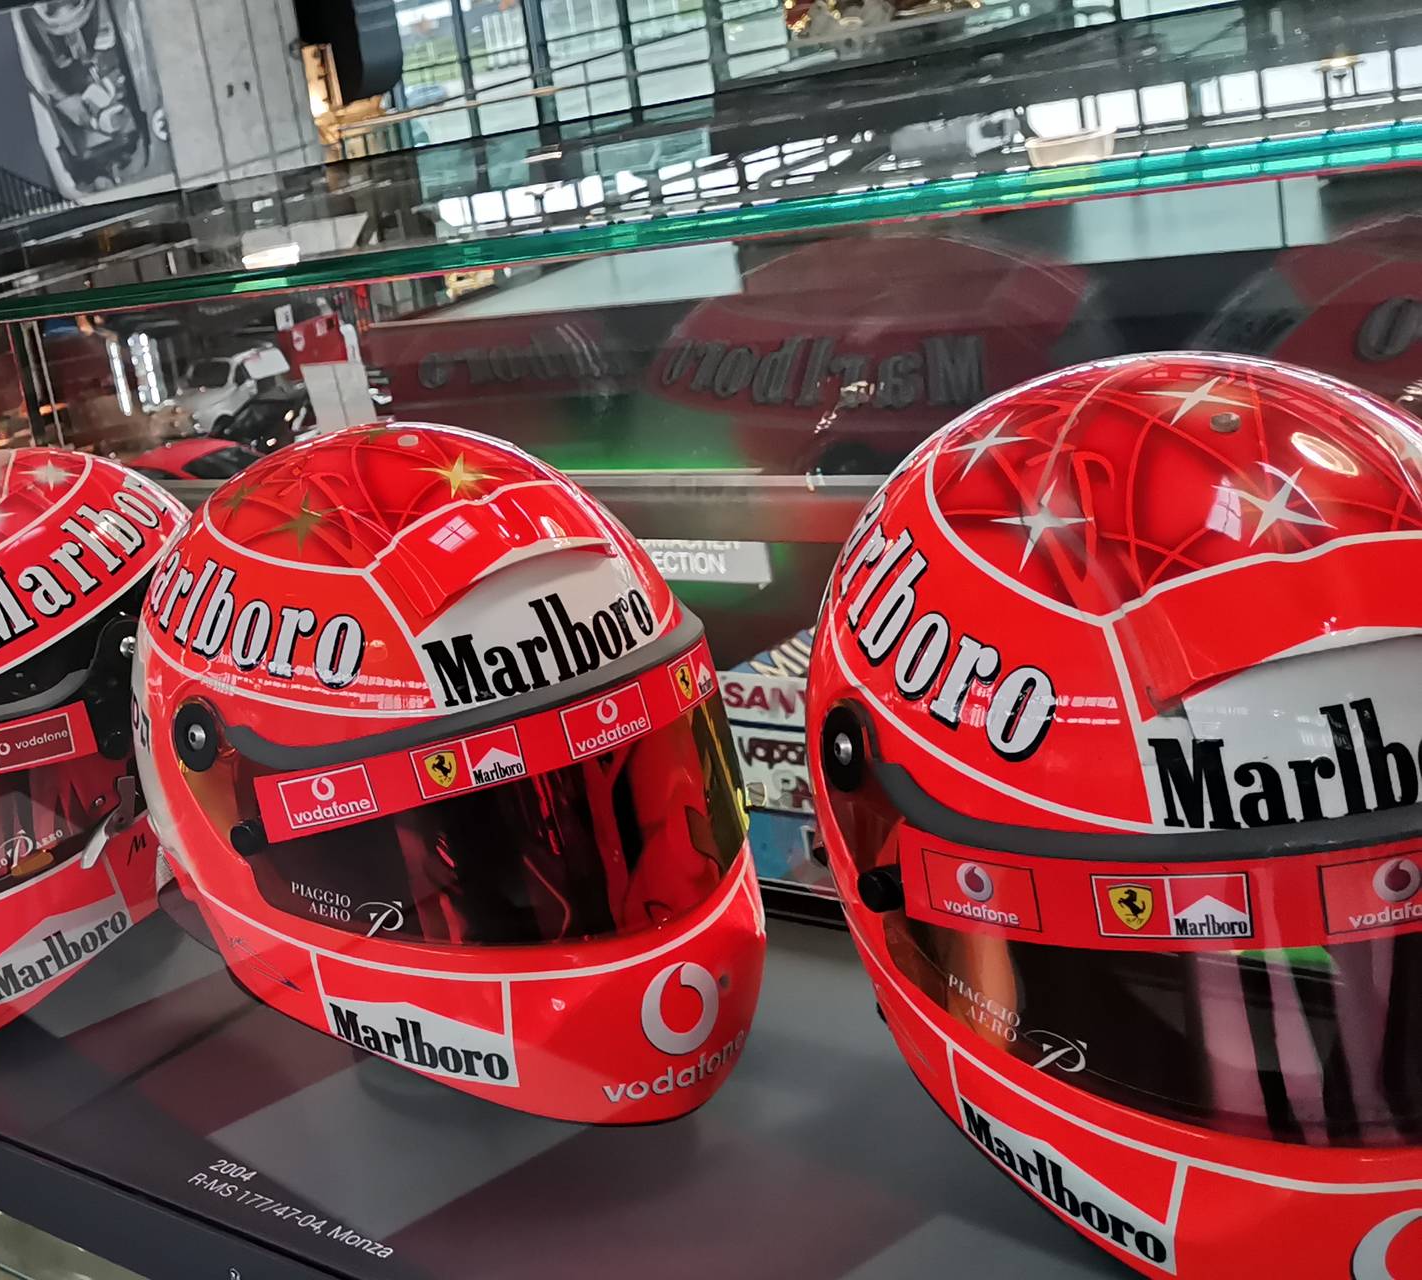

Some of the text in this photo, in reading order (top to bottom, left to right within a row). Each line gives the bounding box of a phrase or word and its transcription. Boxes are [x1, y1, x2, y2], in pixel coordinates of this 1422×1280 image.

[651, 551, 727, 574] ECTION
[149, 550, 367, 690] arlboro
[840, 491, 1057, 763] arlboro
[422, 588, 655, 708] Marlboro
[15, 728, 69, 750] vodafone
[576, 716, 647, 753] vodafone
[473, 760, 524, 785] Marlboro
[293, 798, 371, 824] vodafone
[291, 881, 351, 908] PIAGGIO
[309, 901, 351, 922] AERO
[943, 899, 1020, 926] vodafone
[1174, 914, 1249, 937] Marlboro
[948, 973, 1021, 1028] PIAGGIO
[967, 1004, 1018, 1042] AERO
[329, 1002, 509, 1081] Marlboro
[209, 1159, 258, 1182] 2004
[955, 1096, 1167, 1264] Marlboro
[187, 1172, 394, 1259] R-MS 177/47-04, Monza
